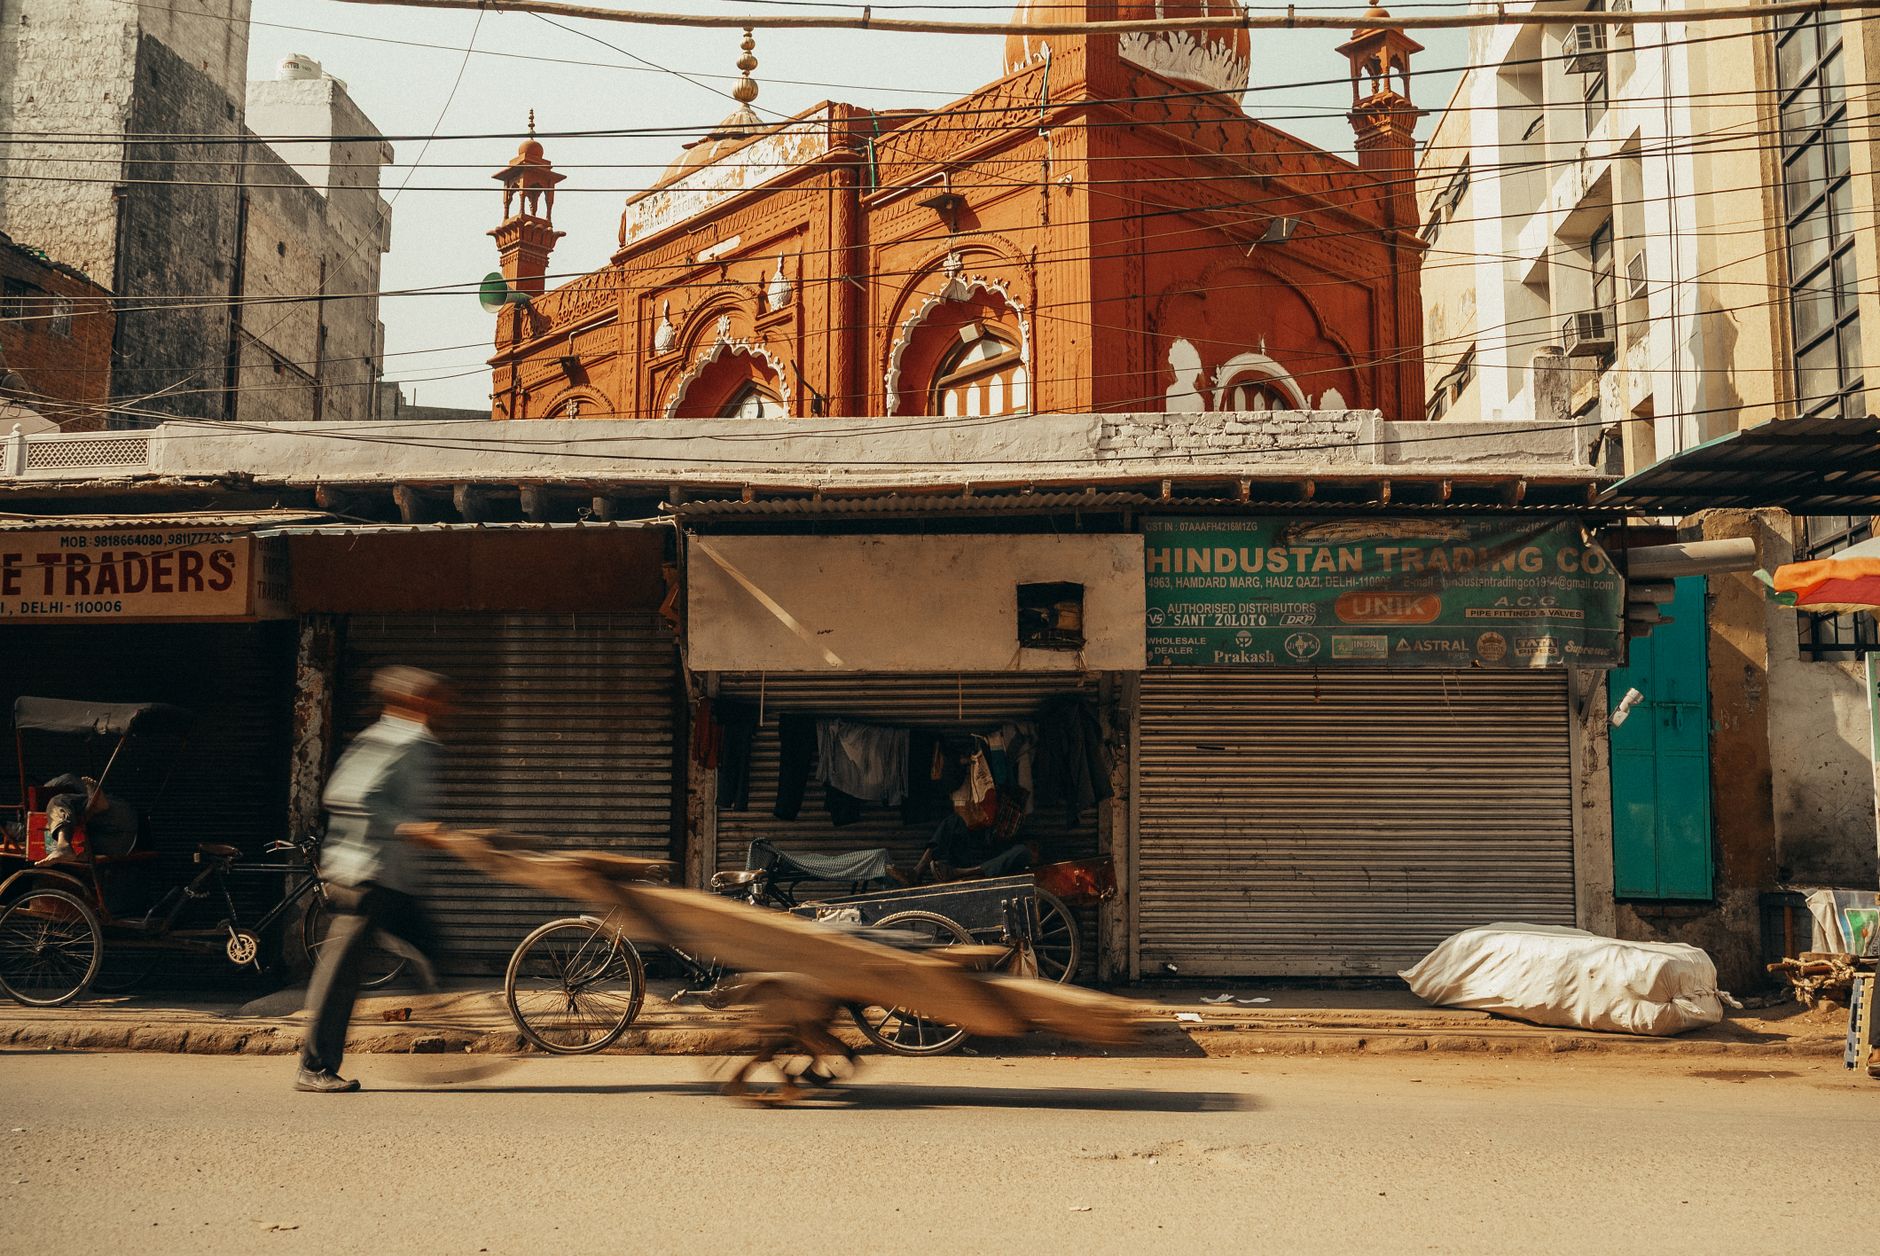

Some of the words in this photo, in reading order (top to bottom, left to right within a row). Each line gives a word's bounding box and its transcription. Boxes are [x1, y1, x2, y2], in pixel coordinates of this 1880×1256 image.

[1146, 547, 1363, 574] HINDUSTAN
[1375, 546, 1544, 574] TRADING
[36, 549, 236, 596] TRADERS
[1147, 576, 1173, 589] 4963,
[1175, 576, 1227, 588] HAMDARD
[1229, 576, 1263, 589] MARG,
[1265, 576, 1293, 588] HAUZ
[1167, 602, 1236, 614] AUTHORISED
[1238, 602, 1317, 614] DISTRIBUTORS
[1352, 596, 1426, 616] UNIK
[1470, 609, 1492, 617] PIPE
[1493, 609, 1536, 617] FITTINGS
[1548, 609, 1582, 618] VALVES
[1147, 637, 1208, 645] WHOLESALE
[1413, 638, 1471, 652] ASTRAL
[1154, 647, 1194, 655] DEALER
[1213, 649, 1276, 664] Prakash
